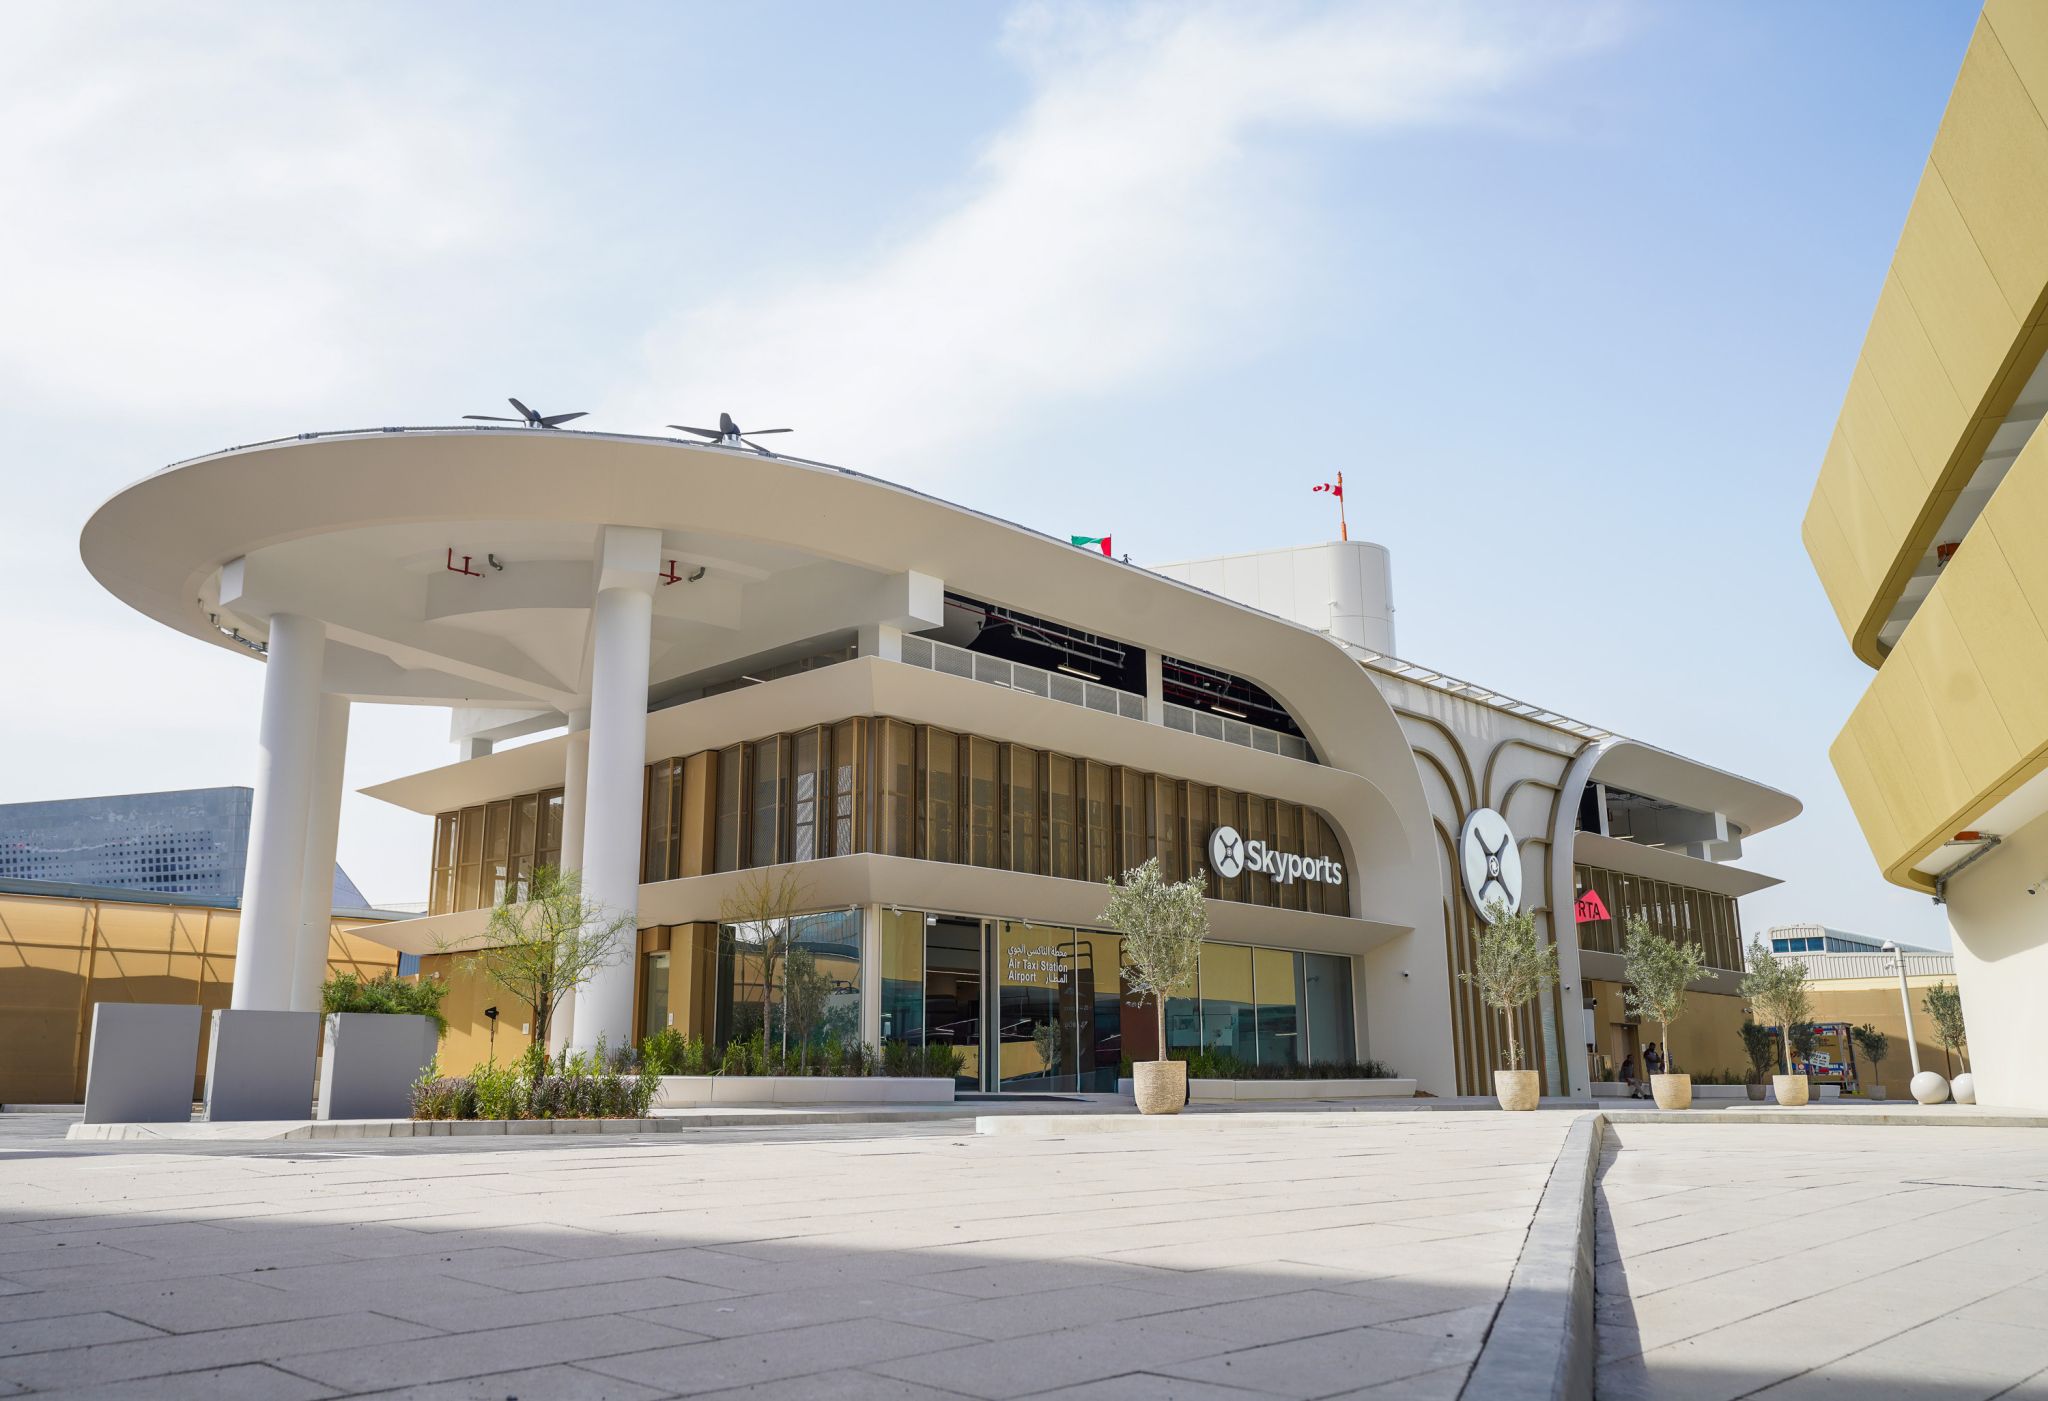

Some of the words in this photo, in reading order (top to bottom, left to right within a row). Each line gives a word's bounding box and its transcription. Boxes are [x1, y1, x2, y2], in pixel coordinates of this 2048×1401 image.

[1247, 840, 1343, 885] Skyports
[1578, 900, 1602, 920] RTA
[1008, 944, 1026, 957] الجوي
[1051, 946, 1067, 957] محطة
[1008, 958, 1021, 969] Air
[1022, 959, 1039, 971] Taxi
[1040, 961, 1068, 973] Station
[1008, 970, 1037, 983] Airport
